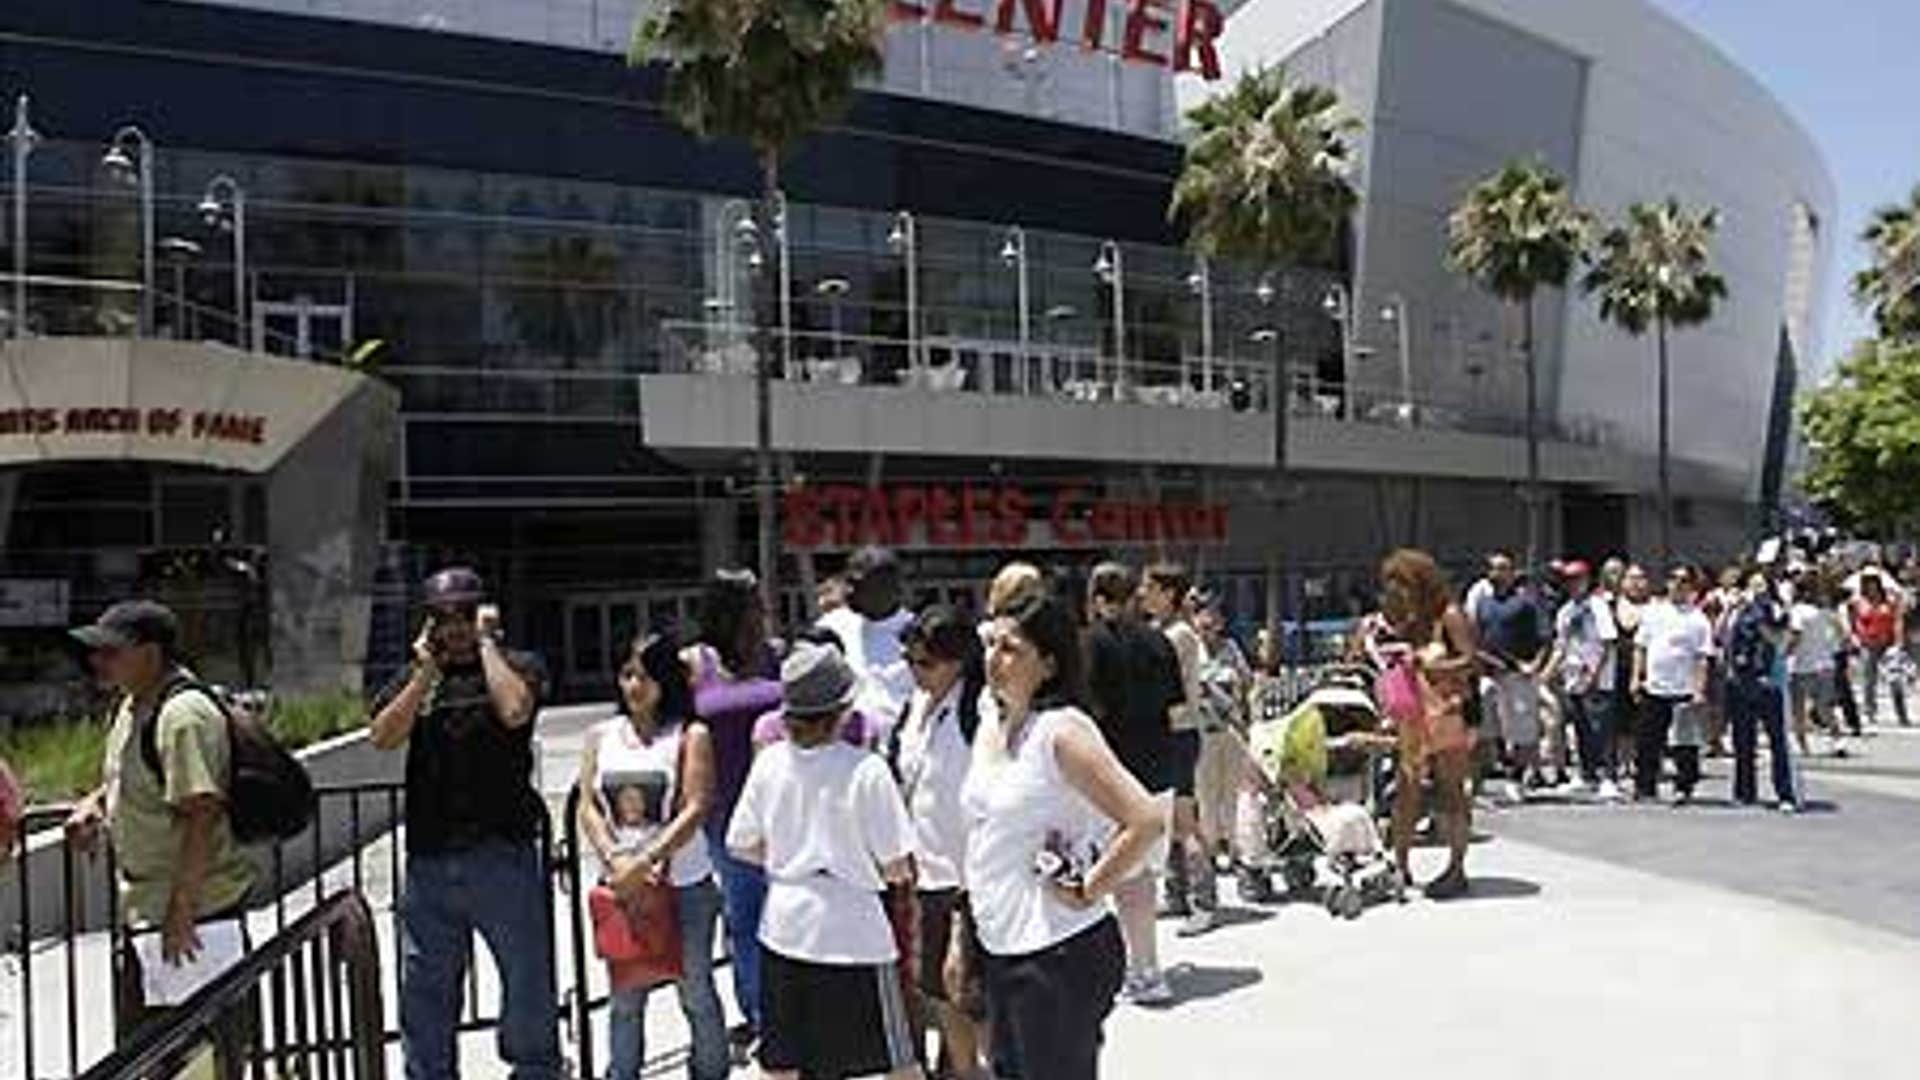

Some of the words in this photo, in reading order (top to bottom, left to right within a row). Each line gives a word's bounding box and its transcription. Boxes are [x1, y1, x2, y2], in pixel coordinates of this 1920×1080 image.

[885, 0, 1225, 80] NTER
[64, 408, 140, 435] ARCH
[147, 409, 181, 436] OF
[192, 412, 267, 444] FAME
[784, 482, 1029, 546] STAPLES
